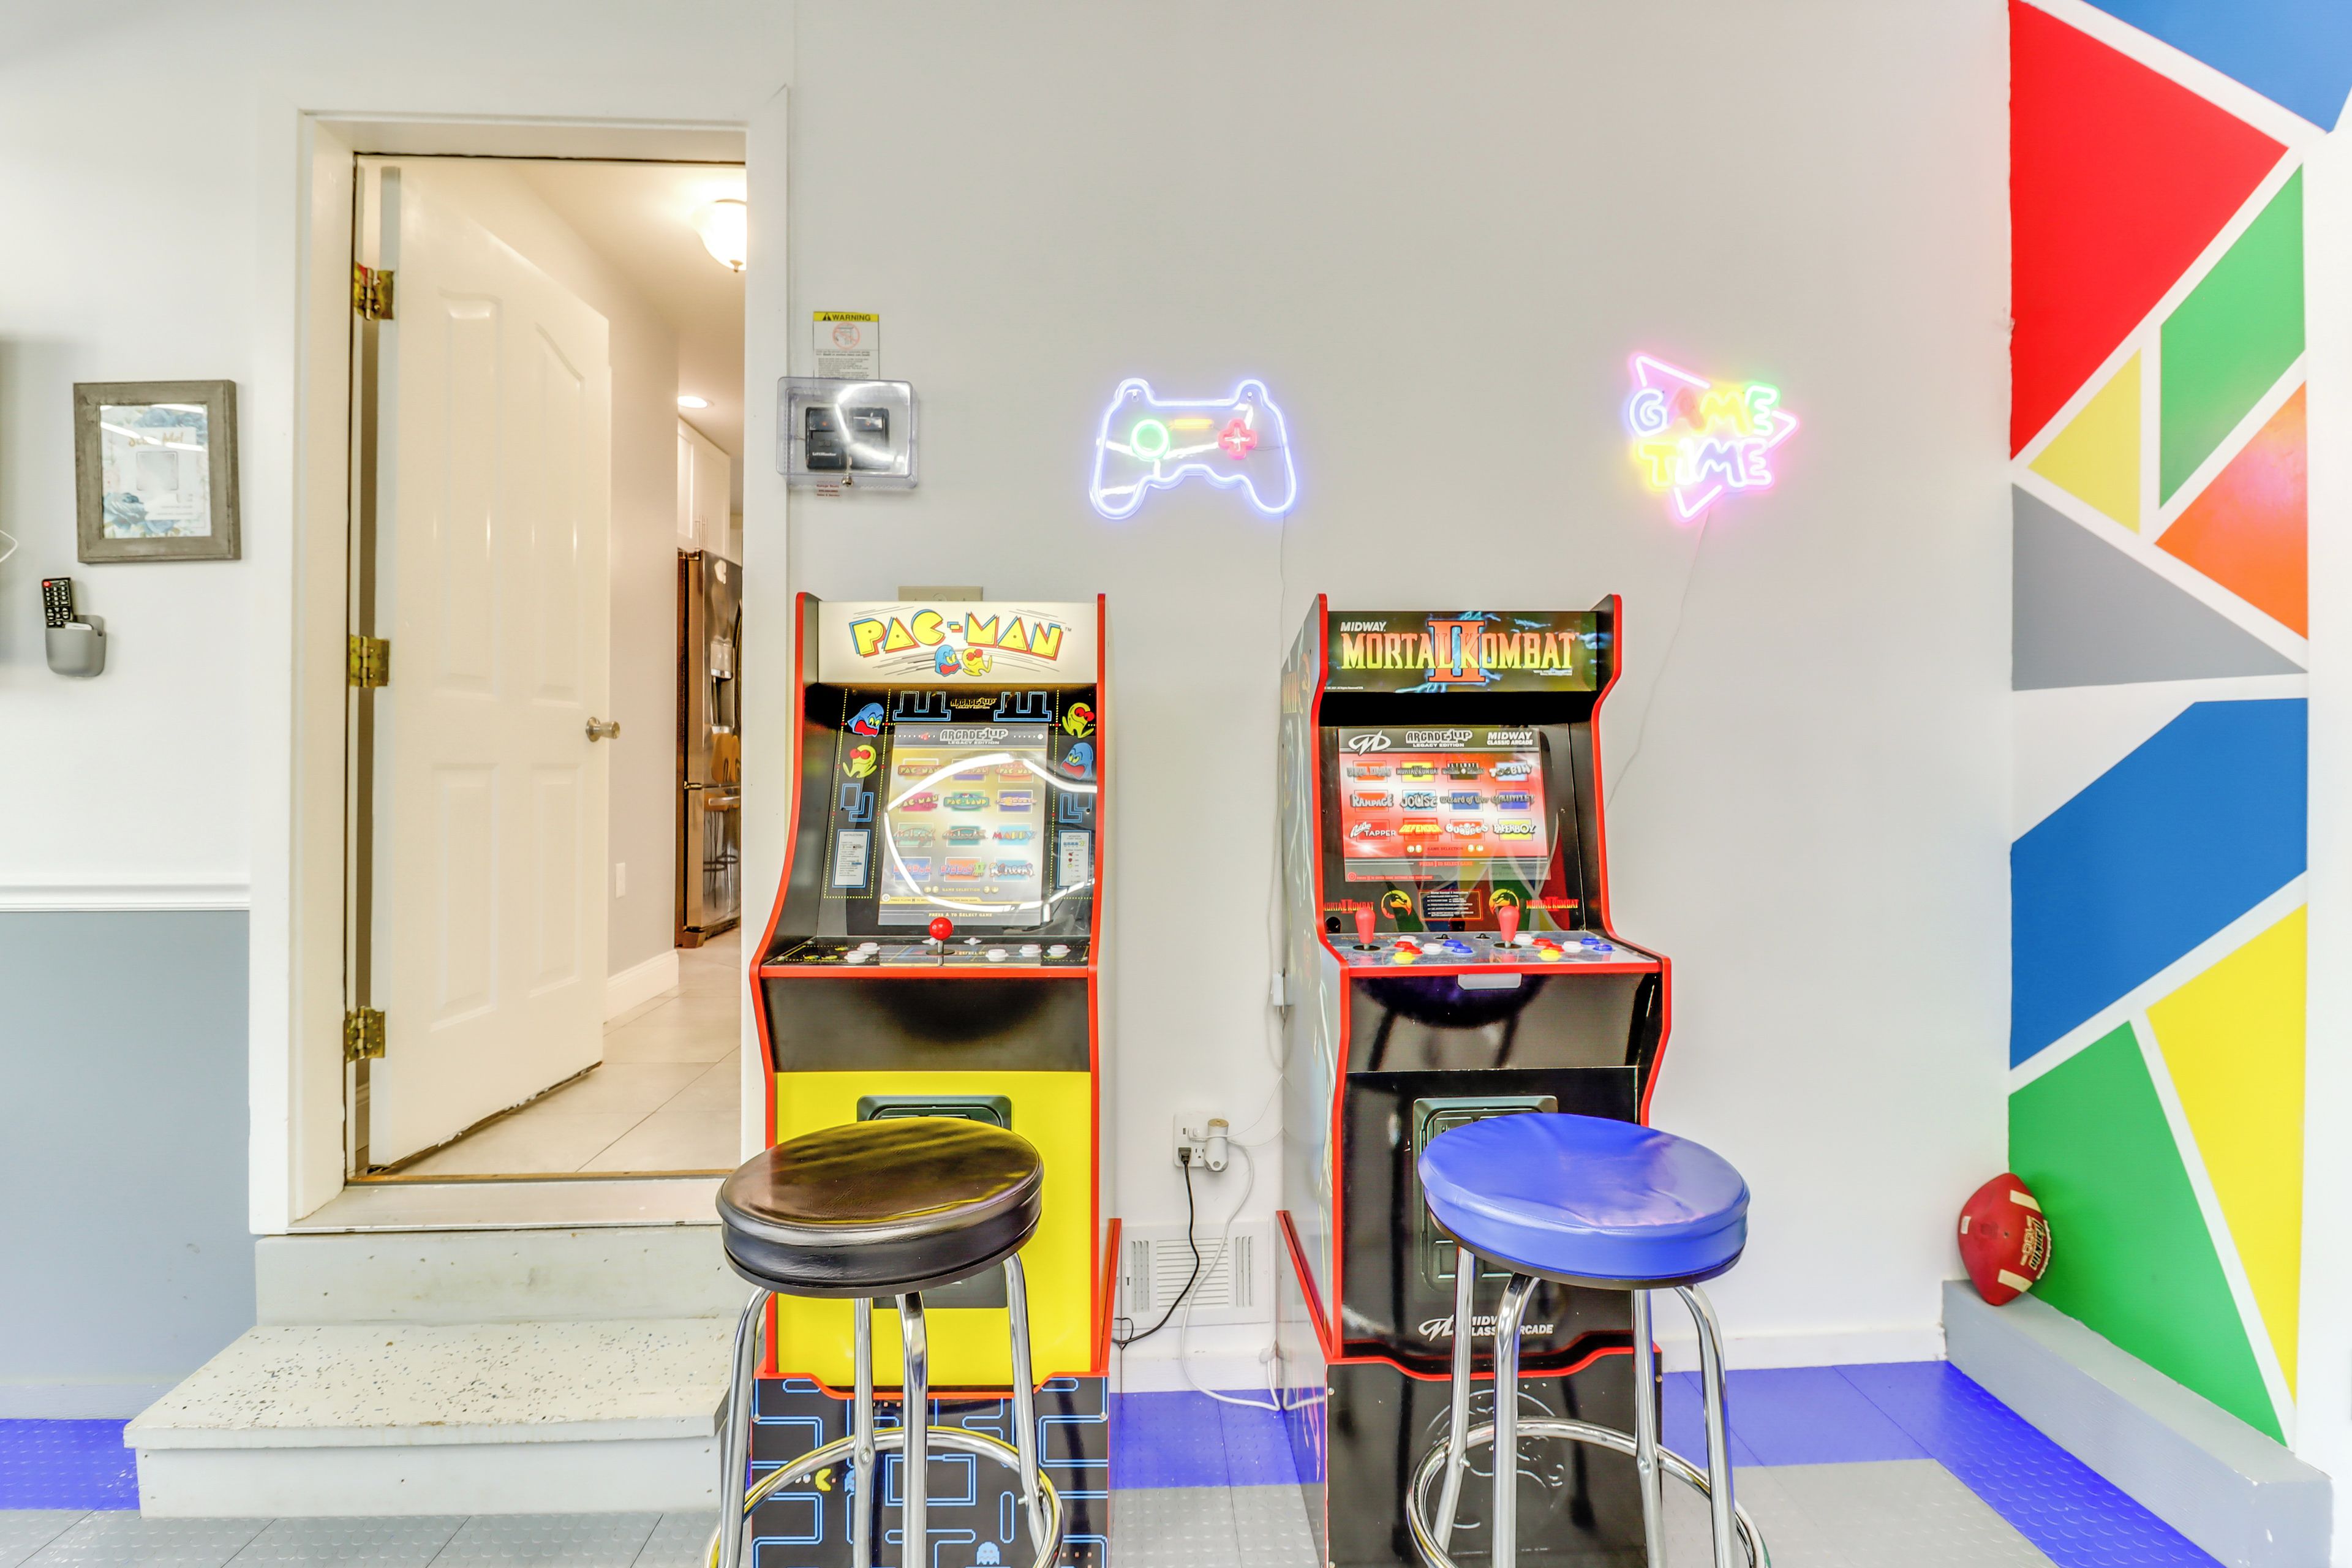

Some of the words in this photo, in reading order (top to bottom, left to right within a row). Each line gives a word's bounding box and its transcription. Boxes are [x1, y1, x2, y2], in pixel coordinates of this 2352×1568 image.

[1628, 385, 1779, 438] GAME
[1638, 437, 1773, 488] TIME
[849, 609, 1065, 661] PAC-MAN
[1341, 632, 1454, 669] MORTAL
[1458, 631, 1575, 669] KOMBAT
[1488, 731, 1532, 741] MIDWAY
[1351, 794, 1393, 807] RAMPAGE
[1398, 824, 1443, 835] DEFENDER
[1493, 823, 1536, 834] PAPERBOY
[1520, 1324, 1555, 1335] RCADE
